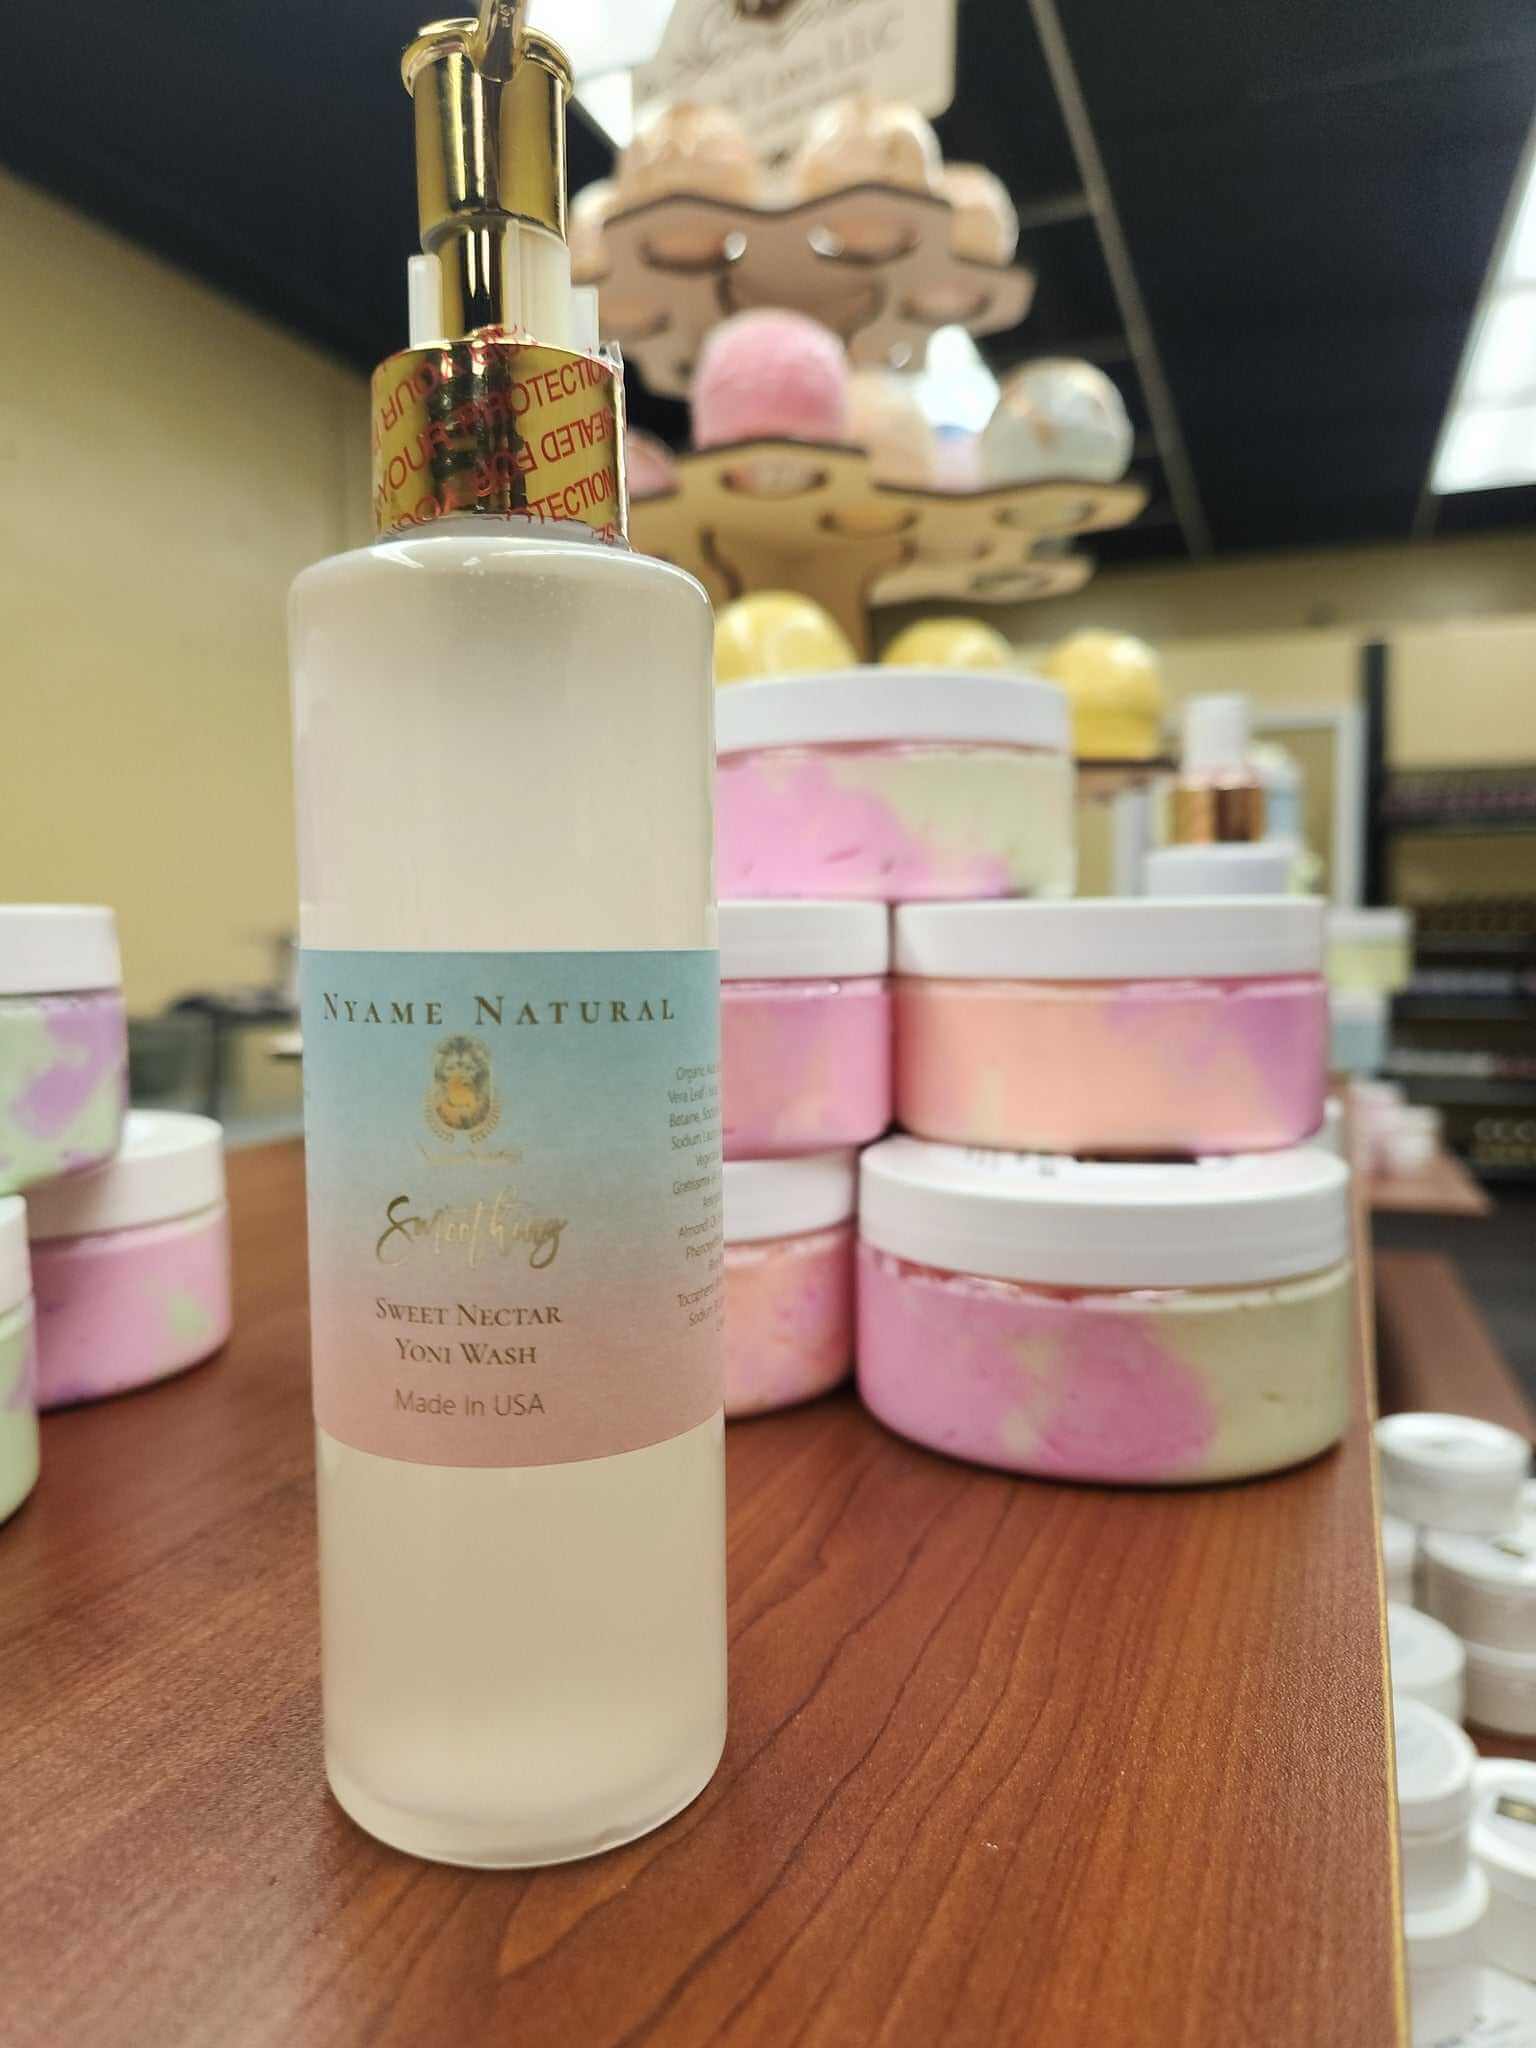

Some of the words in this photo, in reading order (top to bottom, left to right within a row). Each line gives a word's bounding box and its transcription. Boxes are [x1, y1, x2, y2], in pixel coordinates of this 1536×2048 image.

[322, 991, 443, 1025] NYAME
[474, 995, 675, 1025] NATURAL
[375, 1297, 449, 1326] SWEET
[457, 1303, 564, 1327] NECTAR
[395, 1336, 452, 1365] YONI
[459, 1343, 538, 1366] WASH
[394, 1389, 458, 1416] Made
[494, 1393, 546, 1417] USA
